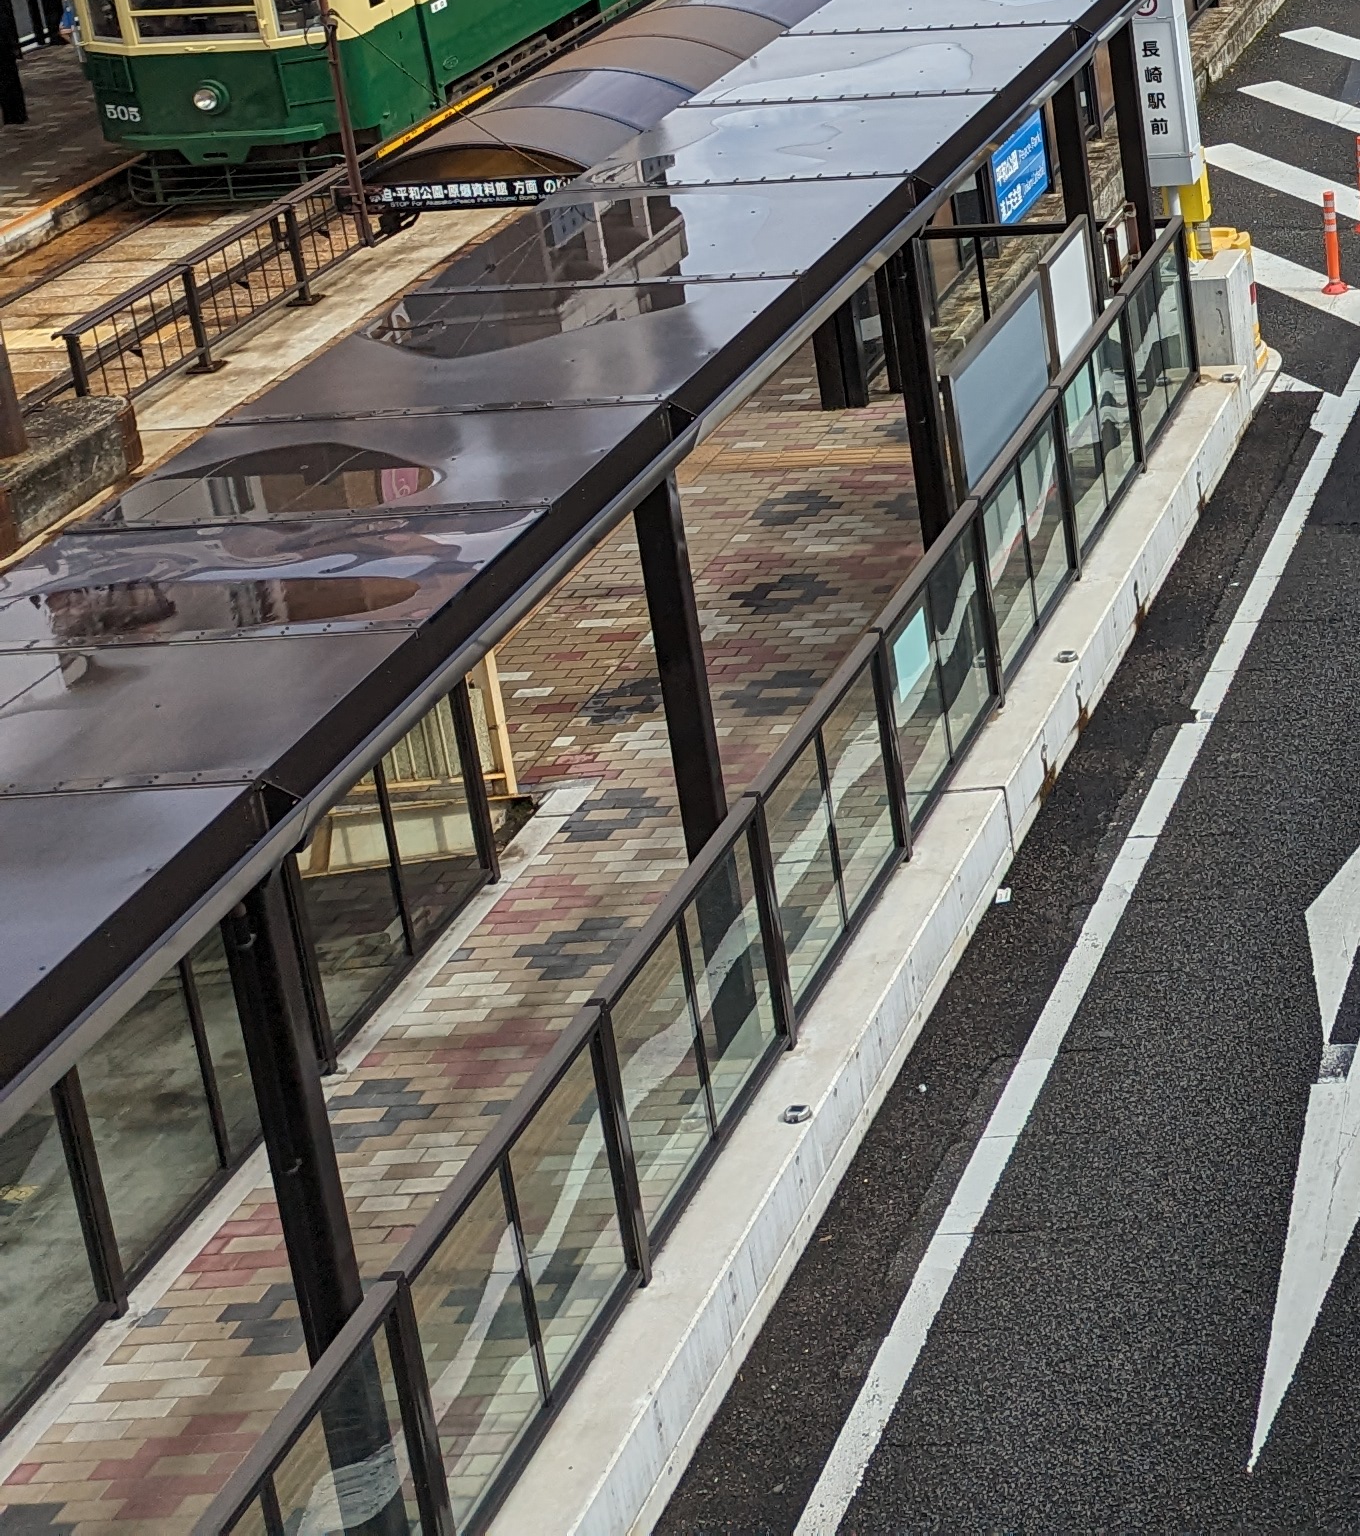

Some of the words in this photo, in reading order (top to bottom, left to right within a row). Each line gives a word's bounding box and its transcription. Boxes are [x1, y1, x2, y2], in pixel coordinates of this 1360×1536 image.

[1141, 40, 1169, 136] 長崎駅前
[105, 104, 142, 122] 505
[513, 179, 538, 195] 方面
